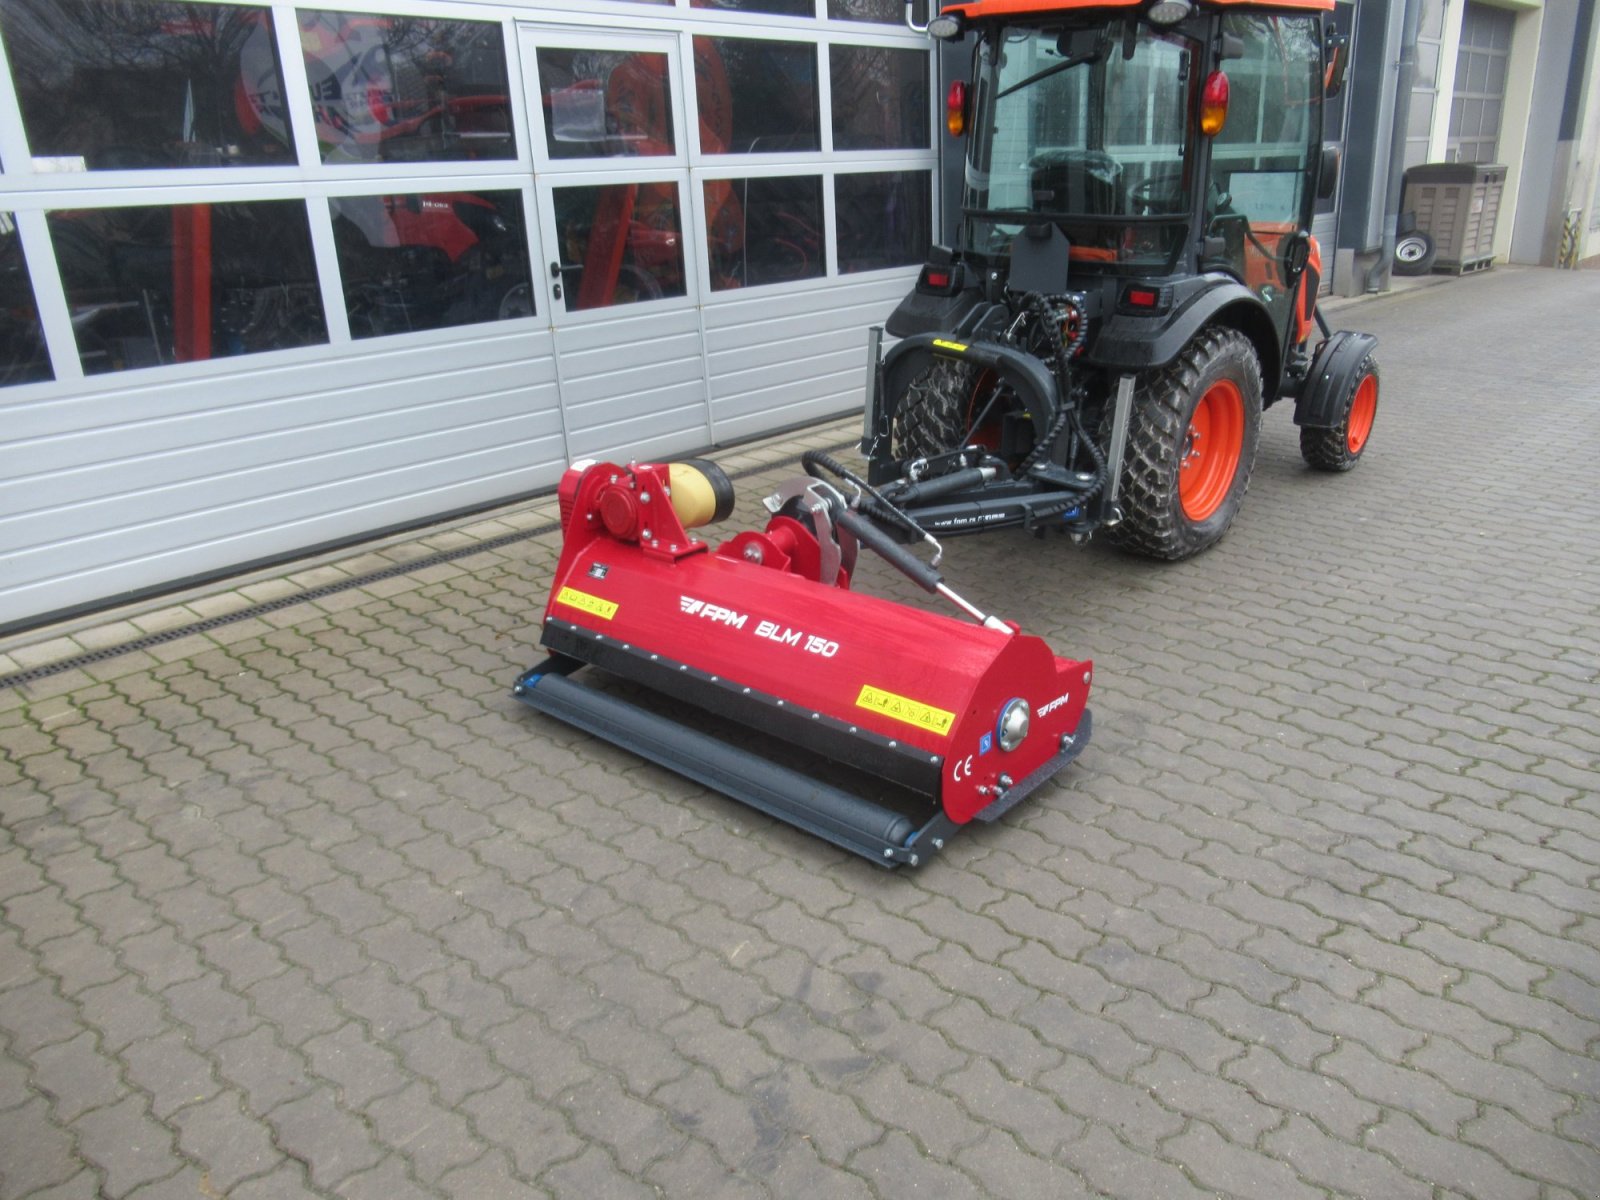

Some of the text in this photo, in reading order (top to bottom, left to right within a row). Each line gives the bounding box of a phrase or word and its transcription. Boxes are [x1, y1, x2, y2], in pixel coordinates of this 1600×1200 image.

[700, 603, 840, 658] FPM BLM 150
[1048, 692, 1069, 713] FPM
